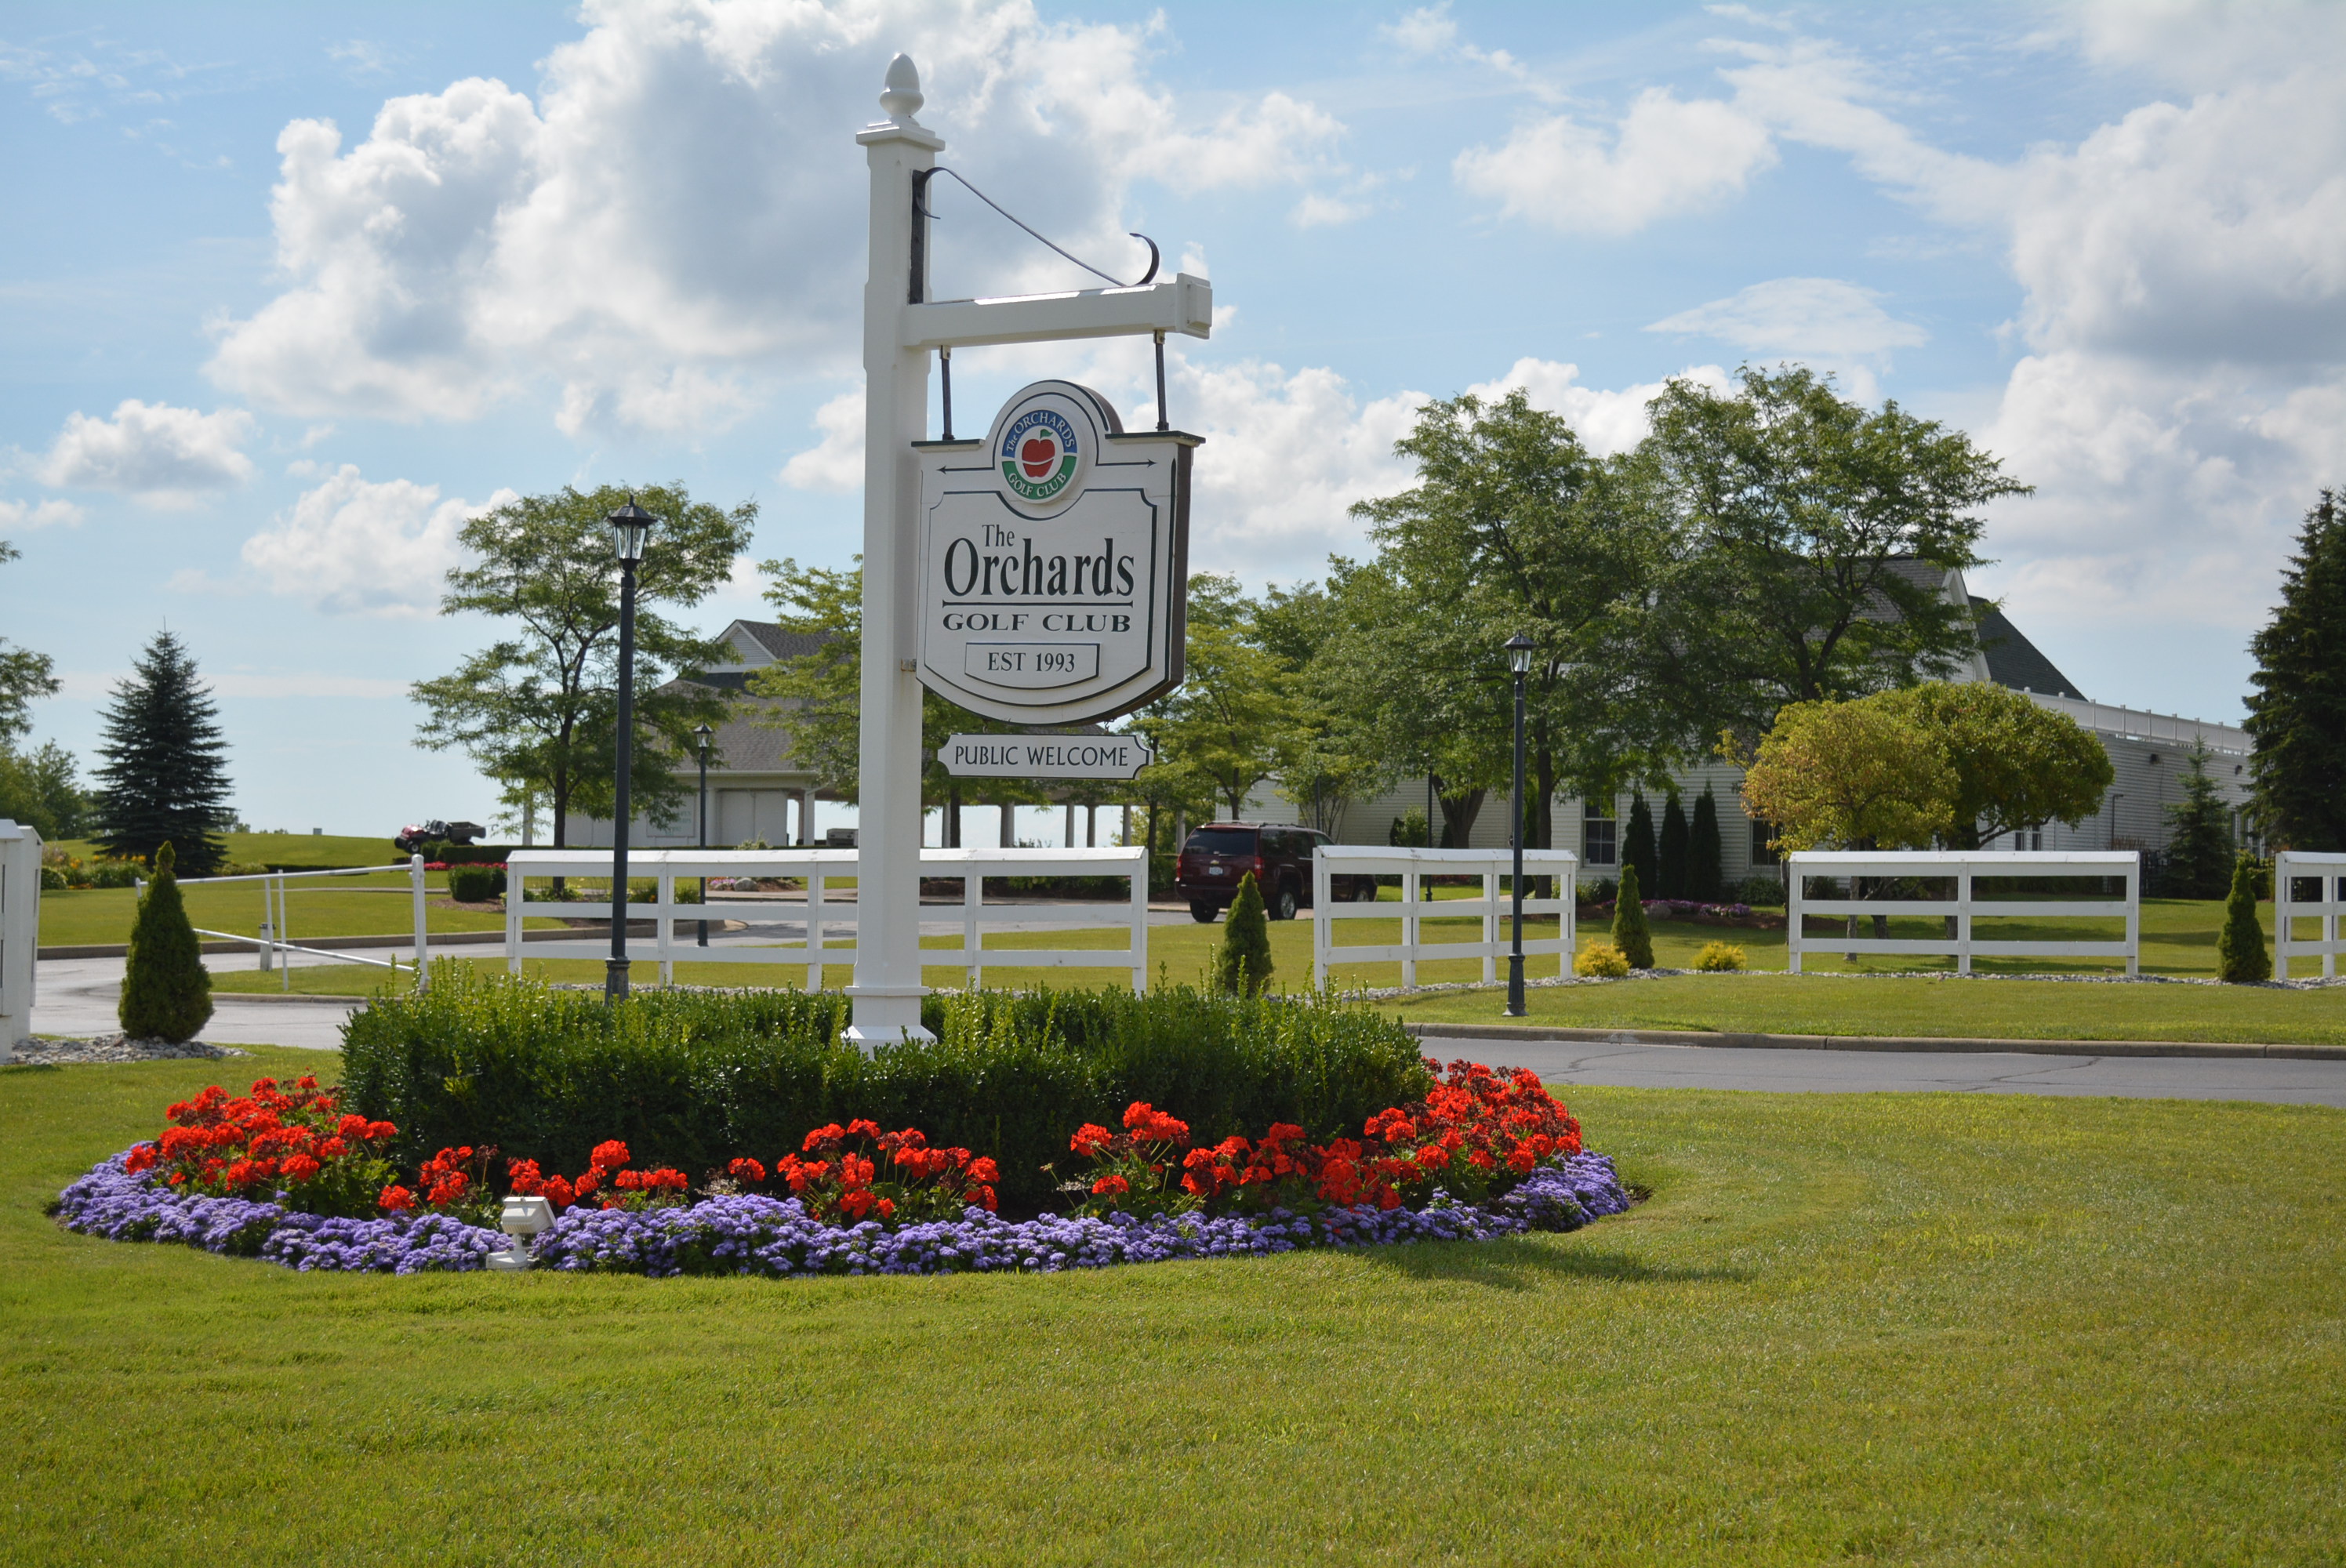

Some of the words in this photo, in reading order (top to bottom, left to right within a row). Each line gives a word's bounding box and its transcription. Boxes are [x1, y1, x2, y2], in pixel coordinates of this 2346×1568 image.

[1006, 434, 1019, 452] The
[1014, 412, 1075, 448] ORCHARDS
[1008, 472, 1033, 496] GOLF
[1036, 472, 1067, 497] CLUB
[982, 524, 1015, 547] The
[943, 537, 1135, 597] Orchards
[942, 613, 1030, 631] GOLF
[1041, 614, 1131, 633] CLUB
[987, 652, 1026, 672] EST
[1035, 652, 1076, 673] 1993
[954, 746, 1019, 766] PUBLIC
[1026, 746, 1129, 767] WELCOME
